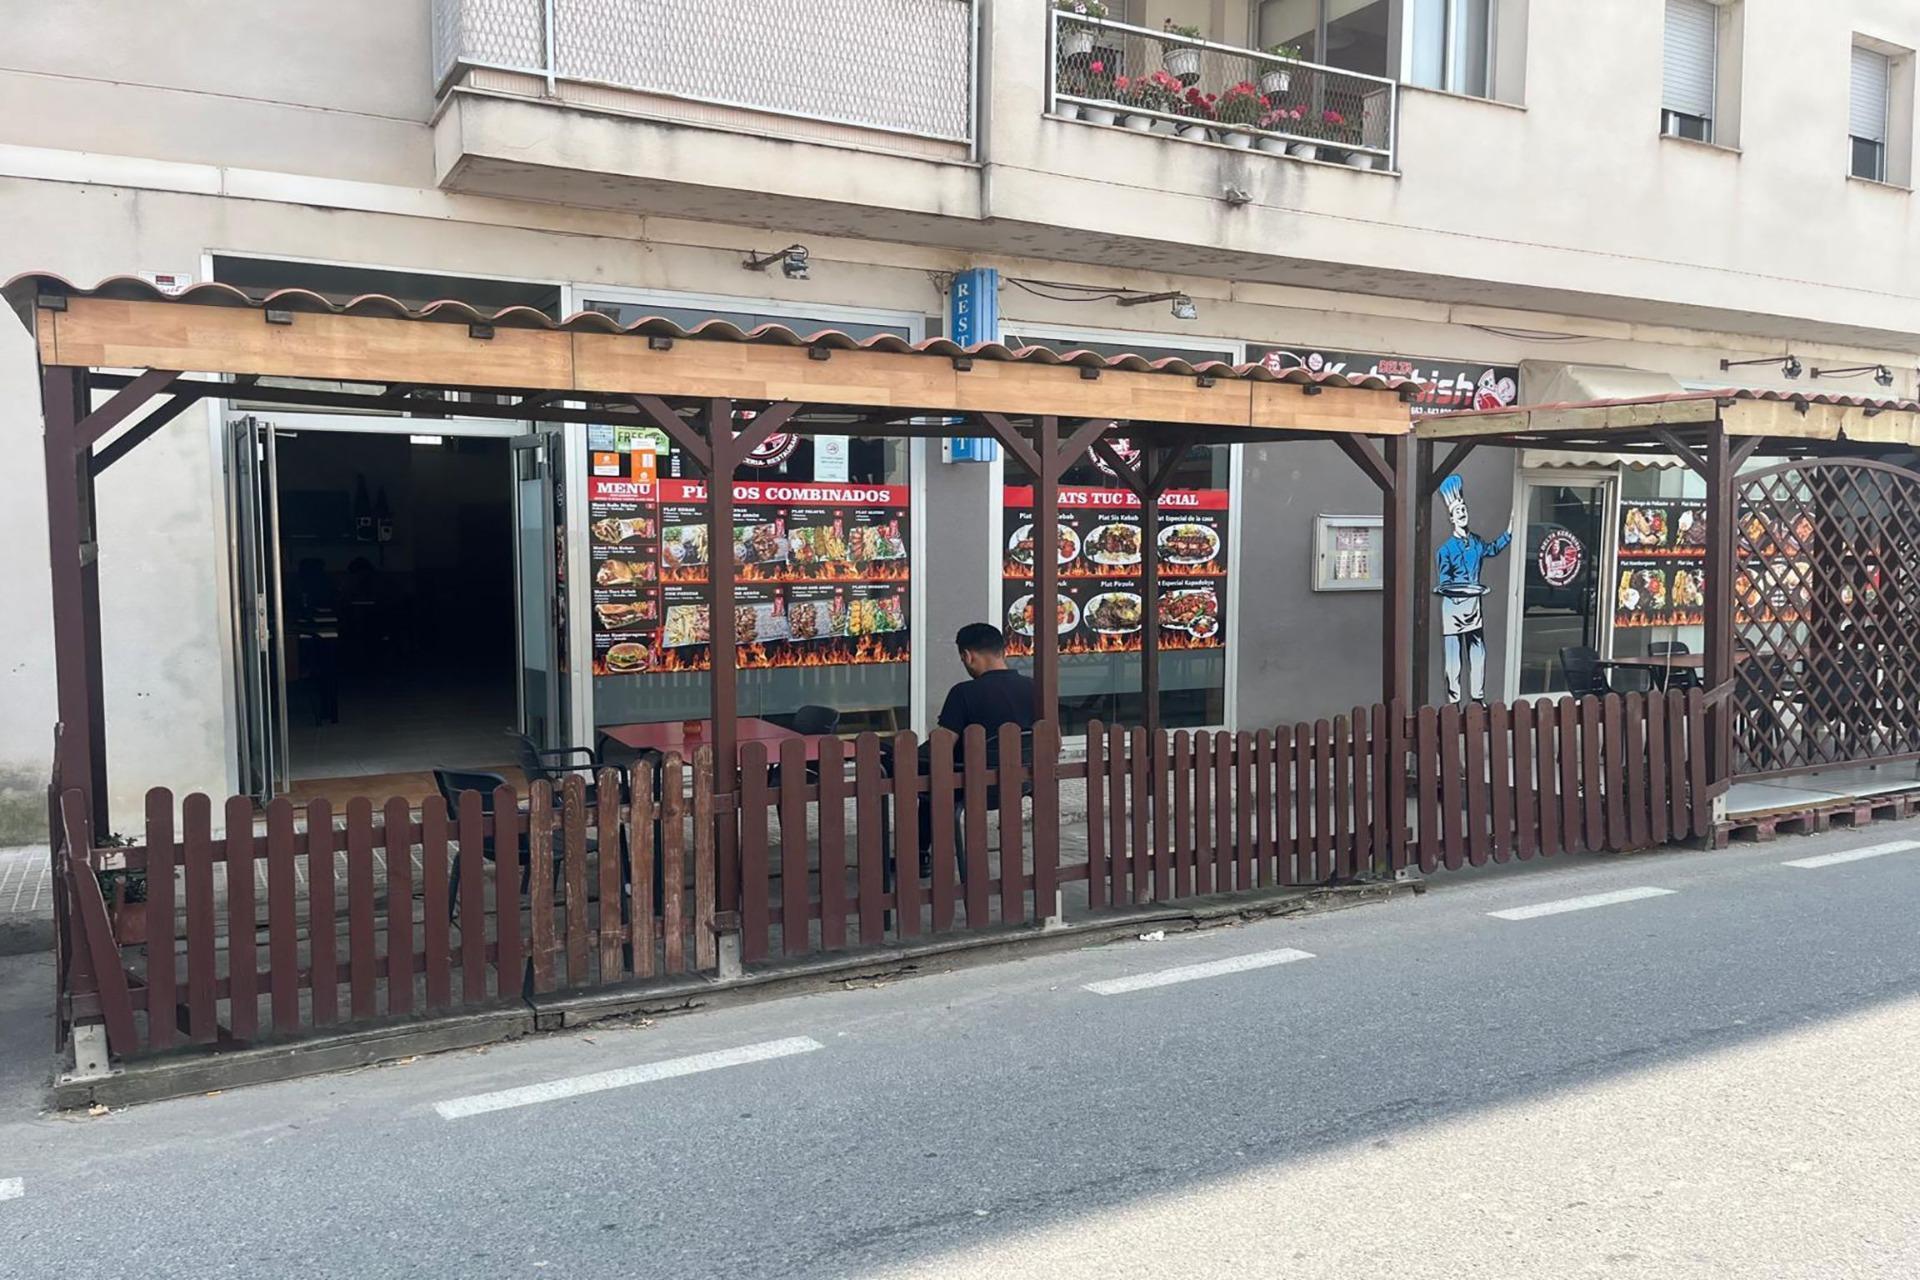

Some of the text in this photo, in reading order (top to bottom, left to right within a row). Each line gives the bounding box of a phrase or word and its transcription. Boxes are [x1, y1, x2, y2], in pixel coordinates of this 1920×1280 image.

[1379, 361, 1412, 374] DELTA
[597, 482, 651, 495] MENU
[682, 485, 891, 502] PLOS COMBINADOS
[1057, 492, 1088, 504] ATS
[1091, 492, 1122, 505] TUC
